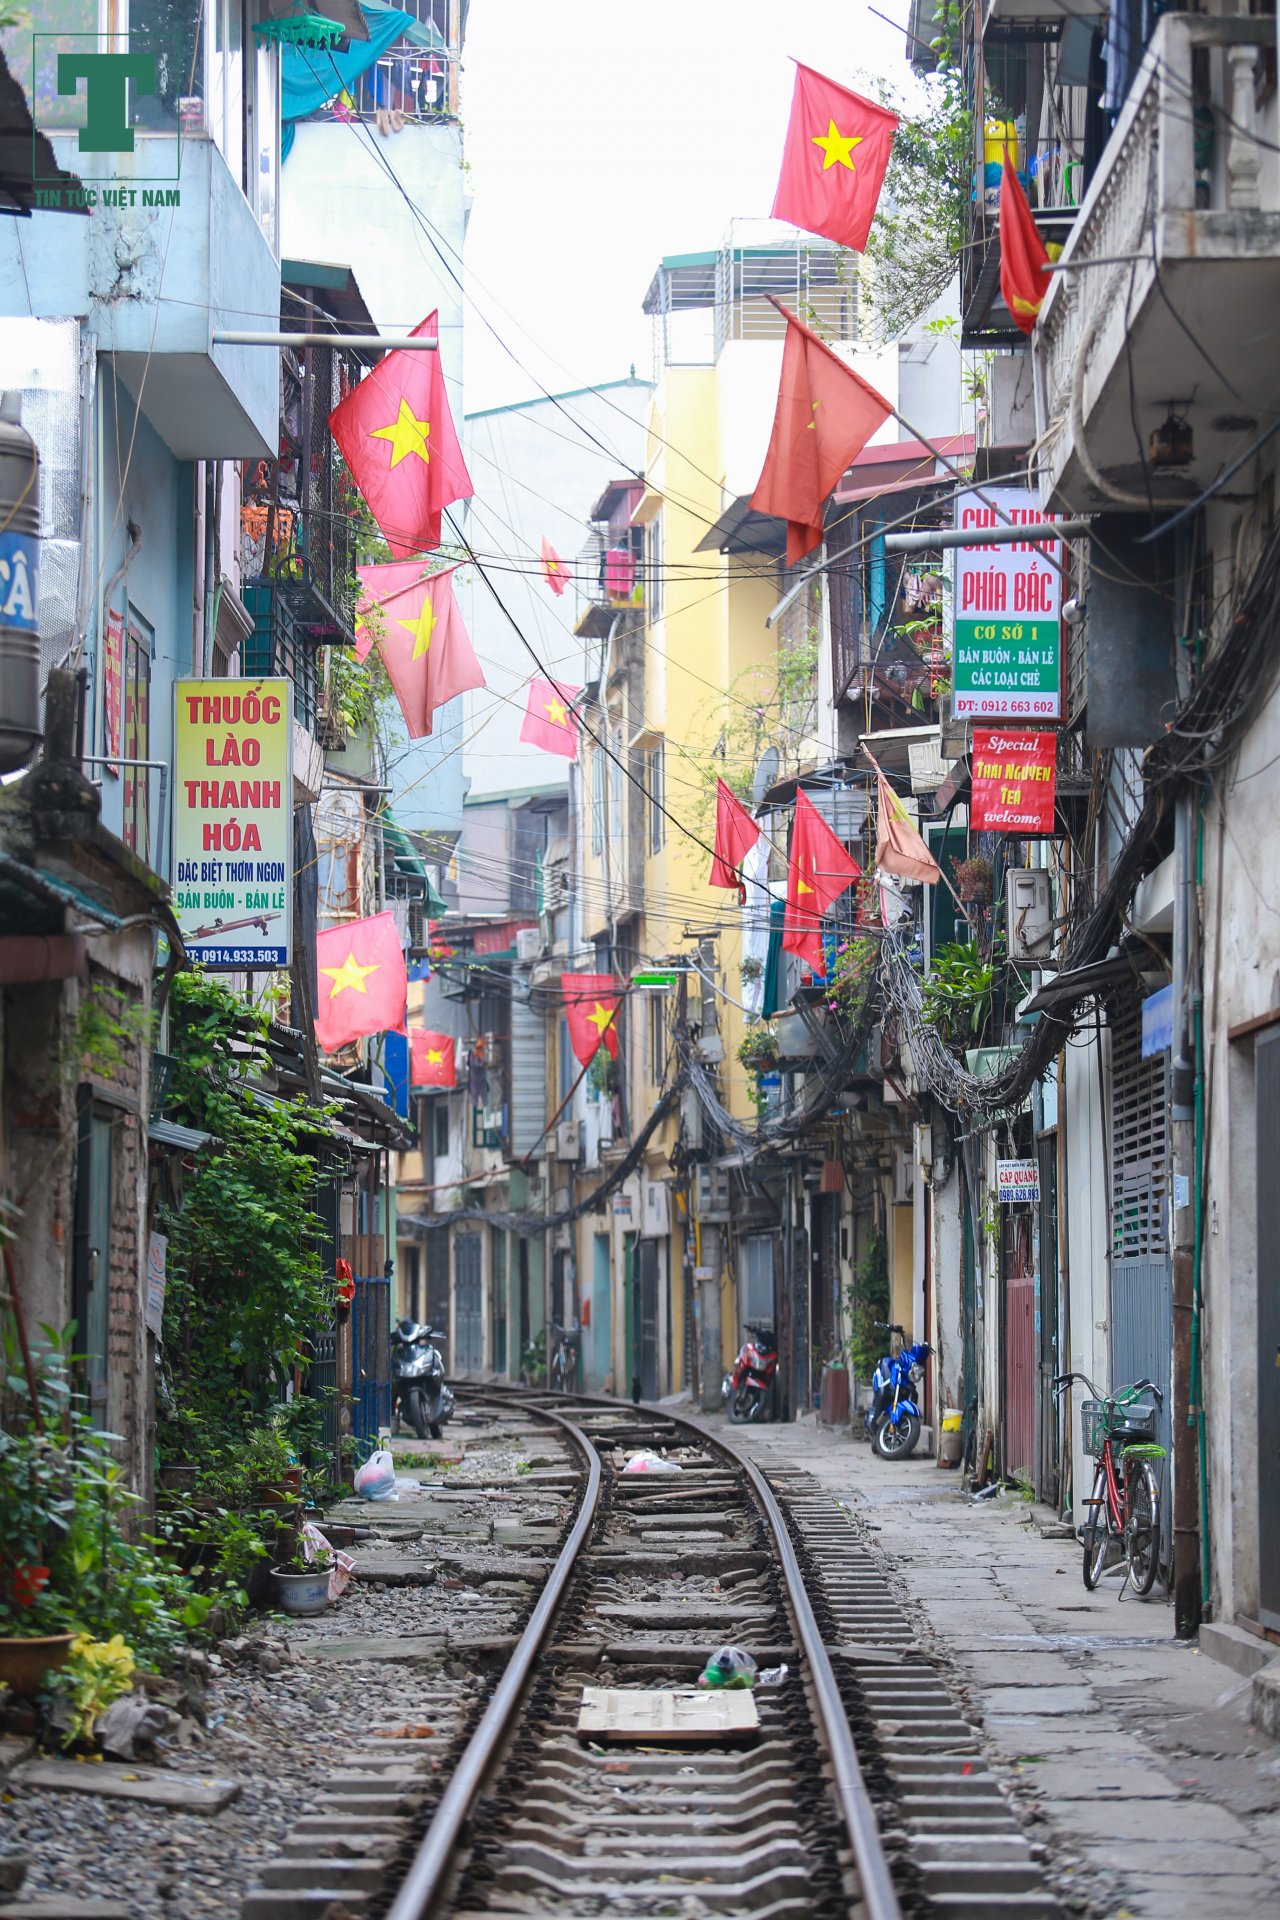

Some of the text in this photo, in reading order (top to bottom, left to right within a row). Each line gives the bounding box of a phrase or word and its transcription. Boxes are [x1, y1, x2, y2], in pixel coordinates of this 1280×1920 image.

[962, 561, 1053, 612] PHÍA BẮC
[974, 622, 1038, 640] CƠ SỞ 1
[958, 646, 980, 664] BÁN
[982, 646, 1011, 664] BUÔN
[1018, 647, 1040, 665] BÁN
[1042, 646, 1054, 665] LẺ
[971, 668, 1041, 690] CÁC LOẠI CHÈ
[186, 686, 281, 725] THUỐC
[957, 700, 1054, 713] ĐT: 0912 663 602
[206, 732, 261, 767] LÀO
[987, 736, 1040, 754] Special
[184, 780, 281, 809] THANH
[983, 810, 1041, 825] welcome
[202, 818, 262, 851] HÓA
[178, 858, 285, 887] ĐẶC BIỆT THƠM NGON
[178, 889, 201, 909] BÁN
[203, 889, 235, 909] BUÔN
[245, 889, 269, 909] BÁN
[272, 886, 285, 909] LẺ
[201, 949, 279, 963] 0914.933.503
[1014, 1170, 1038, 1185] QUANG
